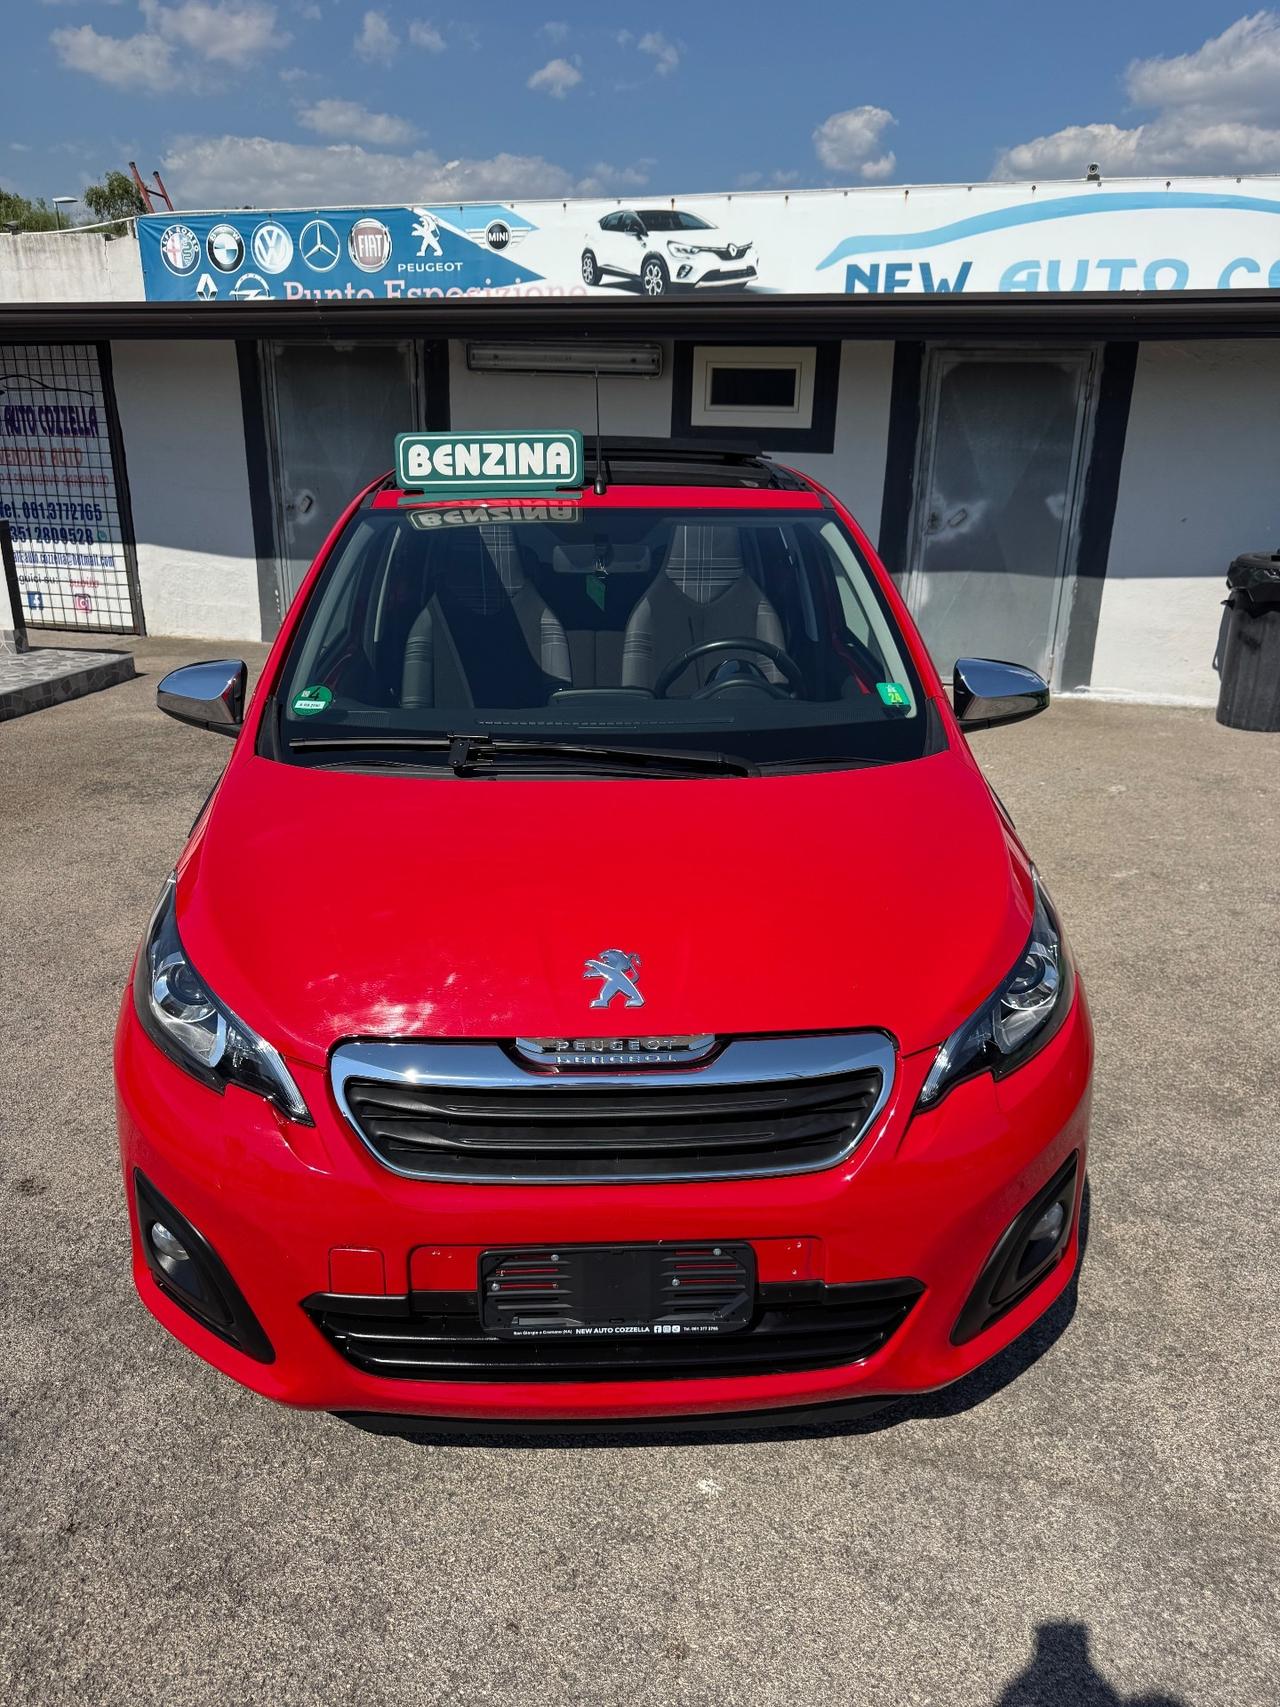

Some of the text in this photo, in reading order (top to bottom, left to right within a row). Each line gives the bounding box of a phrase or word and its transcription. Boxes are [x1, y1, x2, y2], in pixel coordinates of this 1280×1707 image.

[488, 232, 509, 243] MINI
[358, 234, 383, 258] FIAT
[397, 262, 464, 273] PEUGEOT
[845, 257, 1280, 294] NEW AUTO C
[4, 405, 99, 438] AUTO COZZELLA
[407, 442, 571, 476] BENZINA
[308, 686, 322, 701] 4
[556, 1039, 678, 1051] PEUGEOT
[575, 1327, 593, 1335] NEW
[594, 1326, 614, 1334] AUTO
[614, 1326, 650, 1334] COZZELLA
